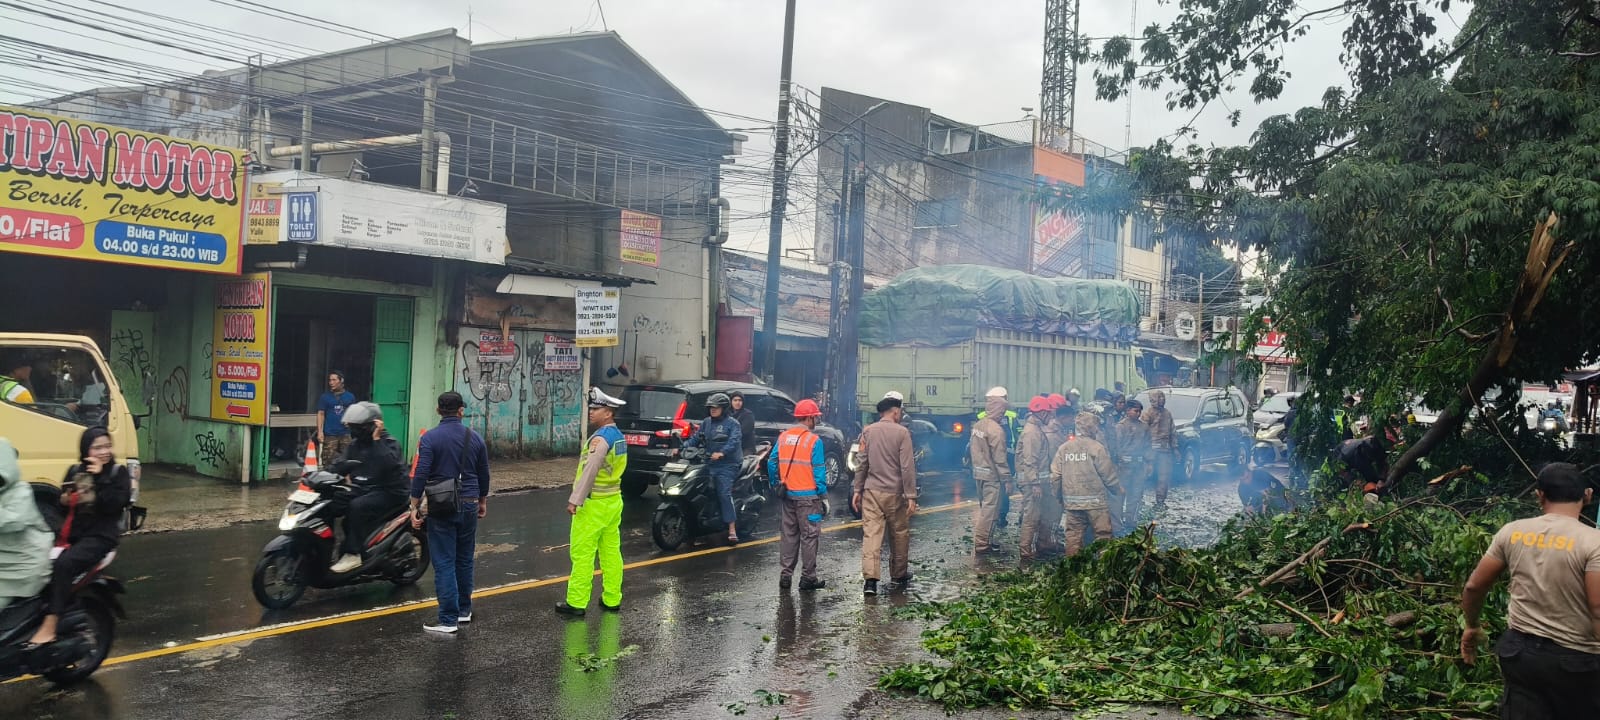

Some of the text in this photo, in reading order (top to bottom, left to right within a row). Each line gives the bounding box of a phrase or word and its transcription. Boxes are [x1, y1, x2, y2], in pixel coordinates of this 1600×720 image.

[112, 132, 237, 204] MOTOR
[103, 193, 216, 229] Terpercaya
[127, 225, 156, 241] Buka
[158, 229, 189, 245] Pukul
[103, 237, 219, 262] 04.00 s/d 23.00 WIB
[577, 290, 603, 299] Brighton
[223, 312, 256, 342] MOTOR
[553, 347, 573, 355] TATI
[926, 385, 937, 396] RR
[1510, 530, 1576, 552] POLISI
